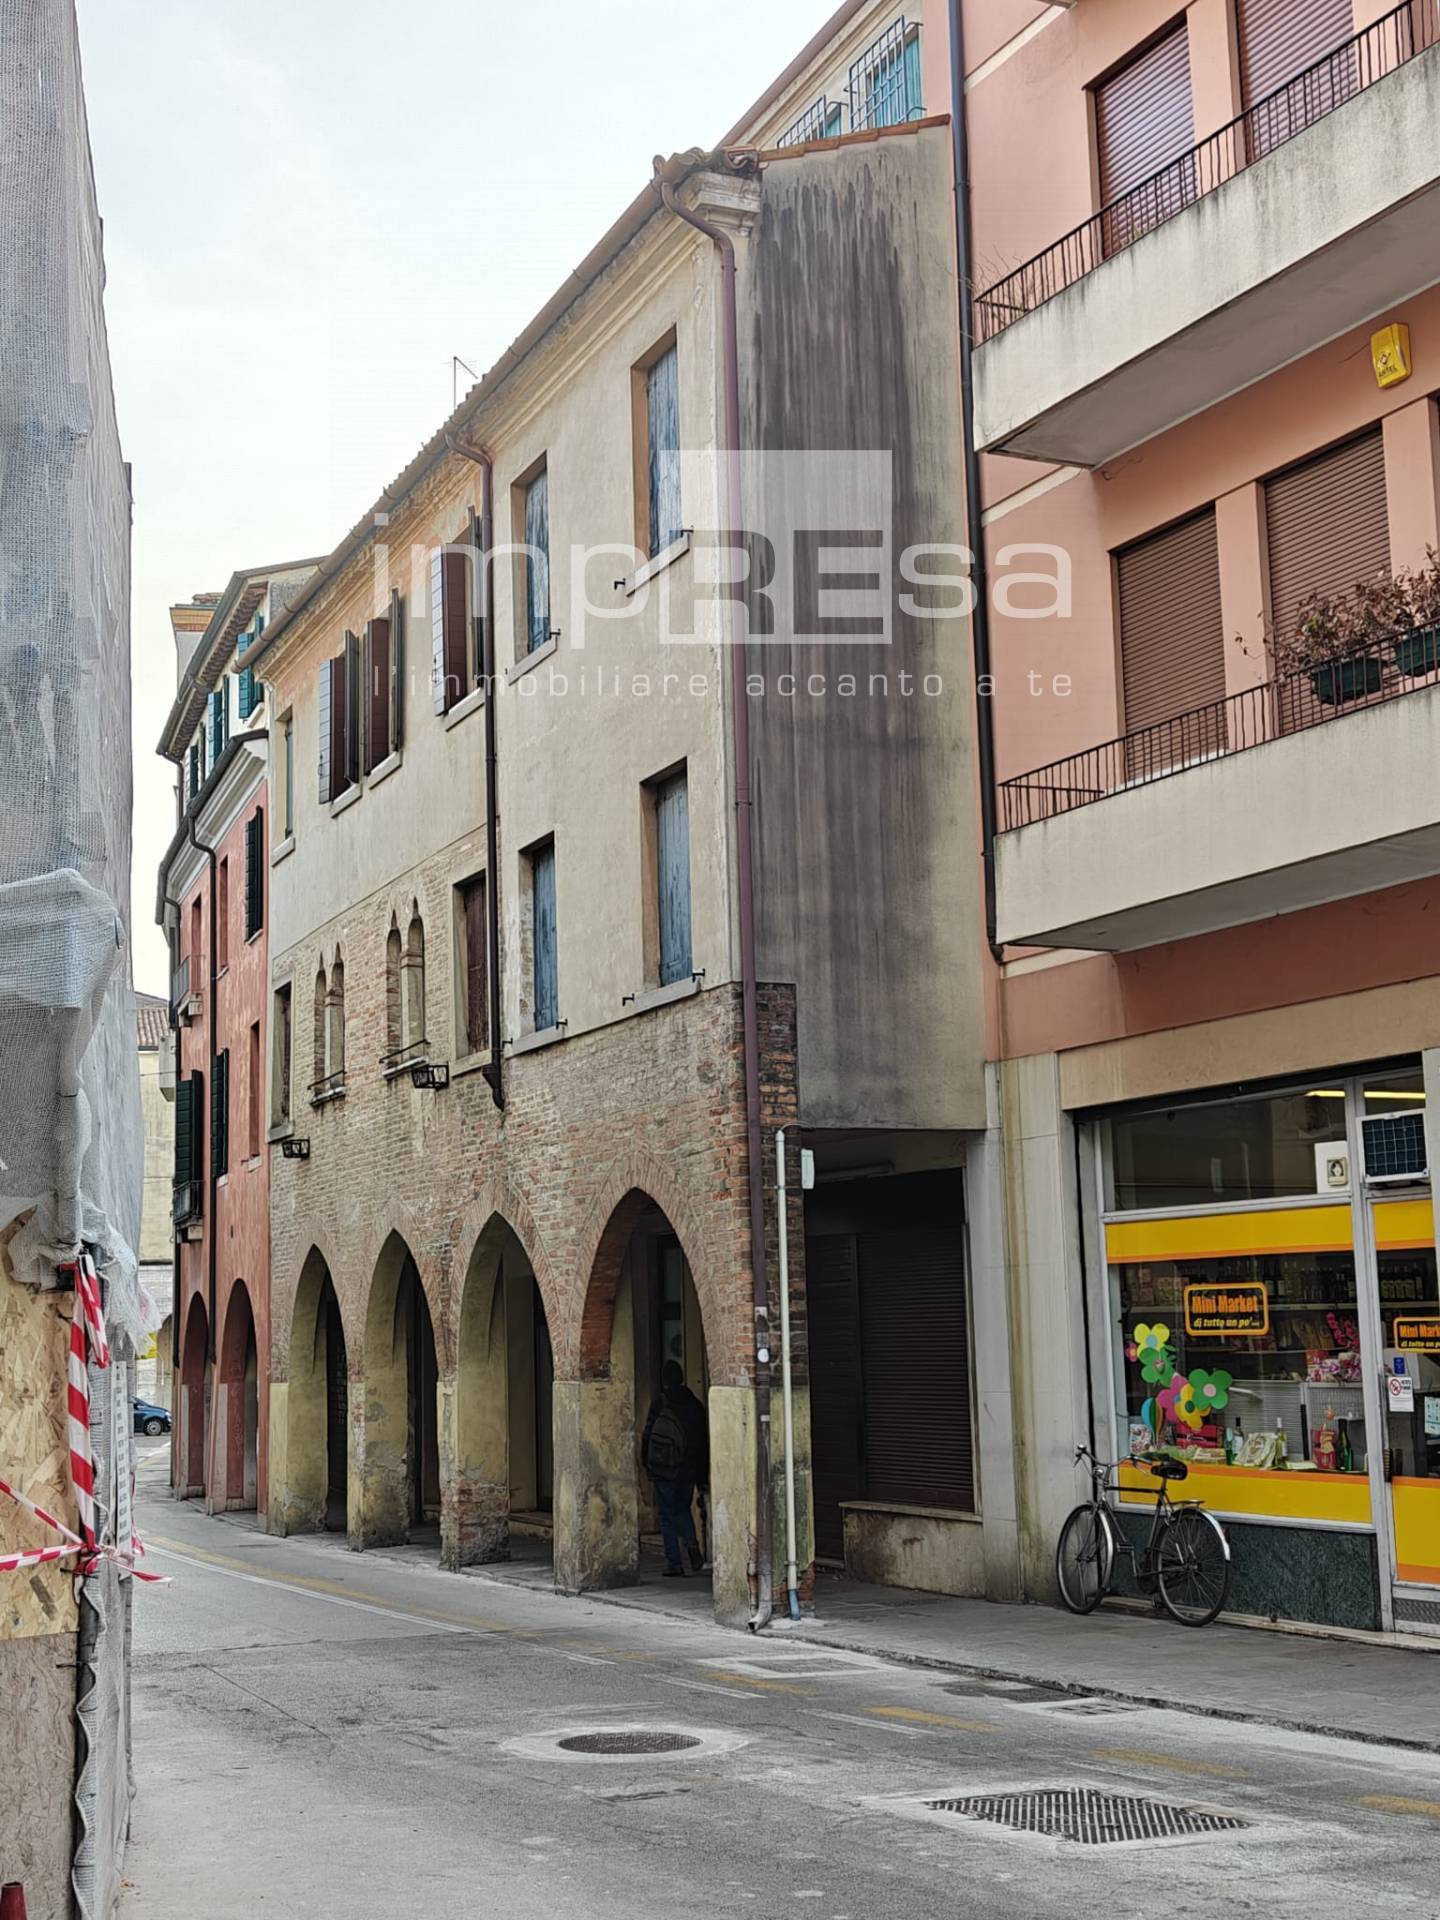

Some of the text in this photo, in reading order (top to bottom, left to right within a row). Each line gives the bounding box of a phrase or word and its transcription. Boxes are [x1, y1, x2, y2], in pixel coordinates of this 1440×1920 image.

[1192, 1294, 1258, 1313] Mini Market
[1193, 1318, 1202, 1328] di
[1203, 1319, 1225, 1328] tutto
[1226, 1319, 1238, 1327] un
[1399, 1325, 1419, 1338] Mini
